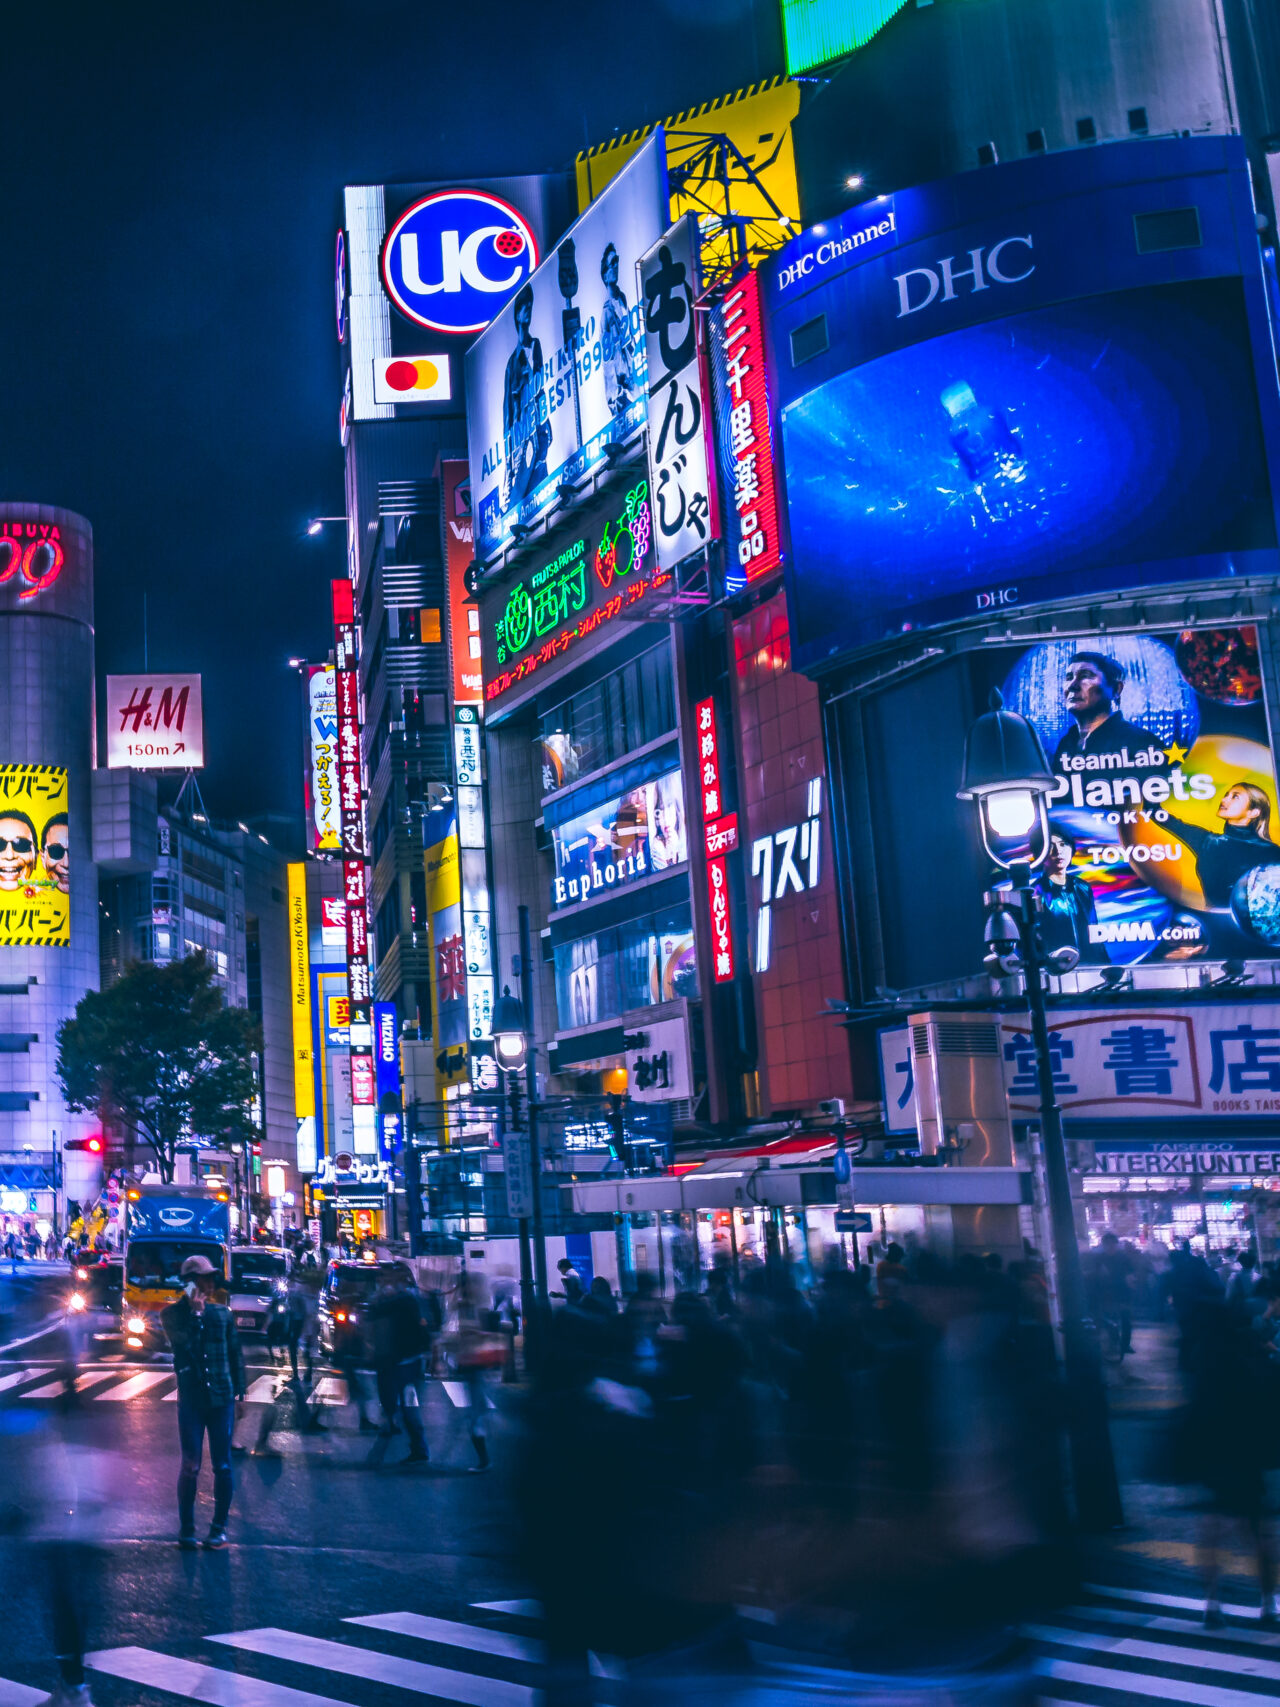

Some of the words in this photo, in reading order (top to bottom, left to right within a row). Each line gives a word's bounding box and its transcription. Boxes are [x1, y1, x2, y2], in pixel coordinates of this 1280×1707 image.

[778, 254, 814, 292] DHC
[816, 213, 896, 265] Channel
[894, 234, 1035, 318] DHC
[644, 245, 708, 539] もんじゃ
[482, 442, 503, 481] ALL
[539, 370, 572, 426] BEST
[721, 291, 763, 565] 三千里薬品
[563, 455, 585, 481] Song
[534, 560, 585, 636] 西村
[976, 588, 1018, 609] DHC
[495, 620, 506, 664] 渋谷
[120, 686, 190, 733] H&M
[127, 744, 169, 757] 150m
[699, 707, 718, 814] お好み焼
[1060, 745, 1165, 772] teamLab
[1045, 768, 1216, 809] Planets
[1092, 809, 1169, 825] TOKYO
[554, 851, 646, 903] Euphoria
[1088, 843, 1182, 865] TOYOSU
[295, 895, 303, 943] KiYoshi
[711, 863, 730, 976] もんじゃ焼
[1088, 921, 1200, 944] DMM.com
[296, 944, 306, 1005] Matsumoto
[381, 1013, 395, 1062] MIZUHO
[894, 1022, 1280, 1110] 堂書店
[1214, 1101, 1249, 1110] BOOKS
[1152, 1143, 1233, 1152] TAISEIDO
